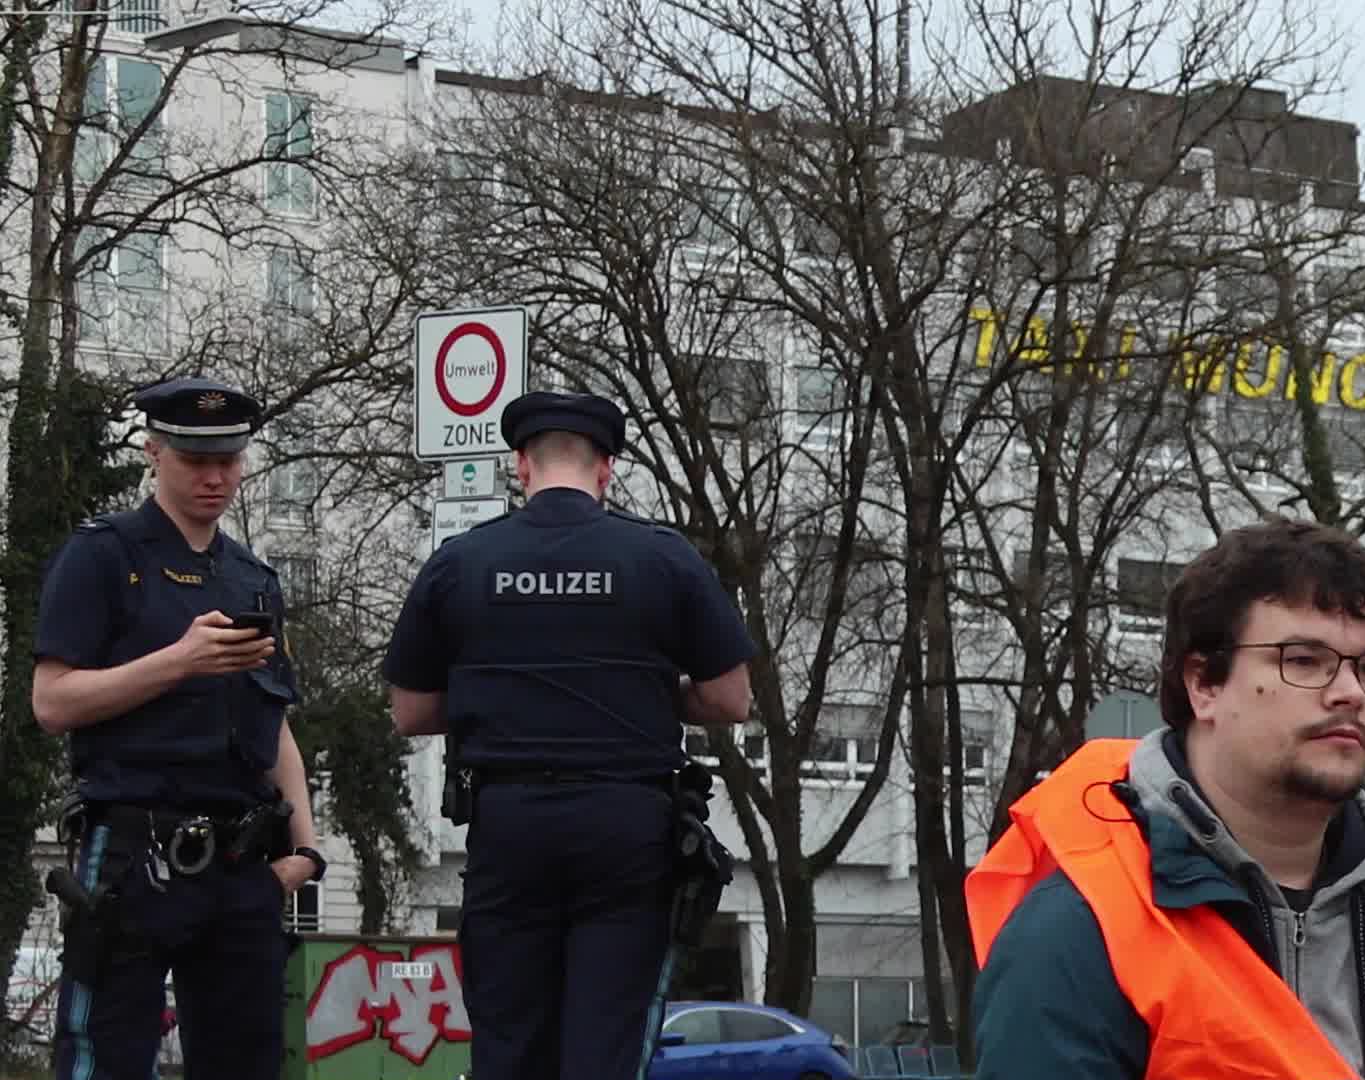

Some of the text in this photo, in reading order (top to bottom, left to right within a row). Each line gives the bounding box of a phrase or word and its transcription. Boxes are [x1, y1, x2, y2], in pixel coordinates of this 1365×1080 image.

[445, 361, 496, 378] Umwelt
[443, 423, 497, 447] ZONE
[496, 572, 613, 594] POLIZEI
